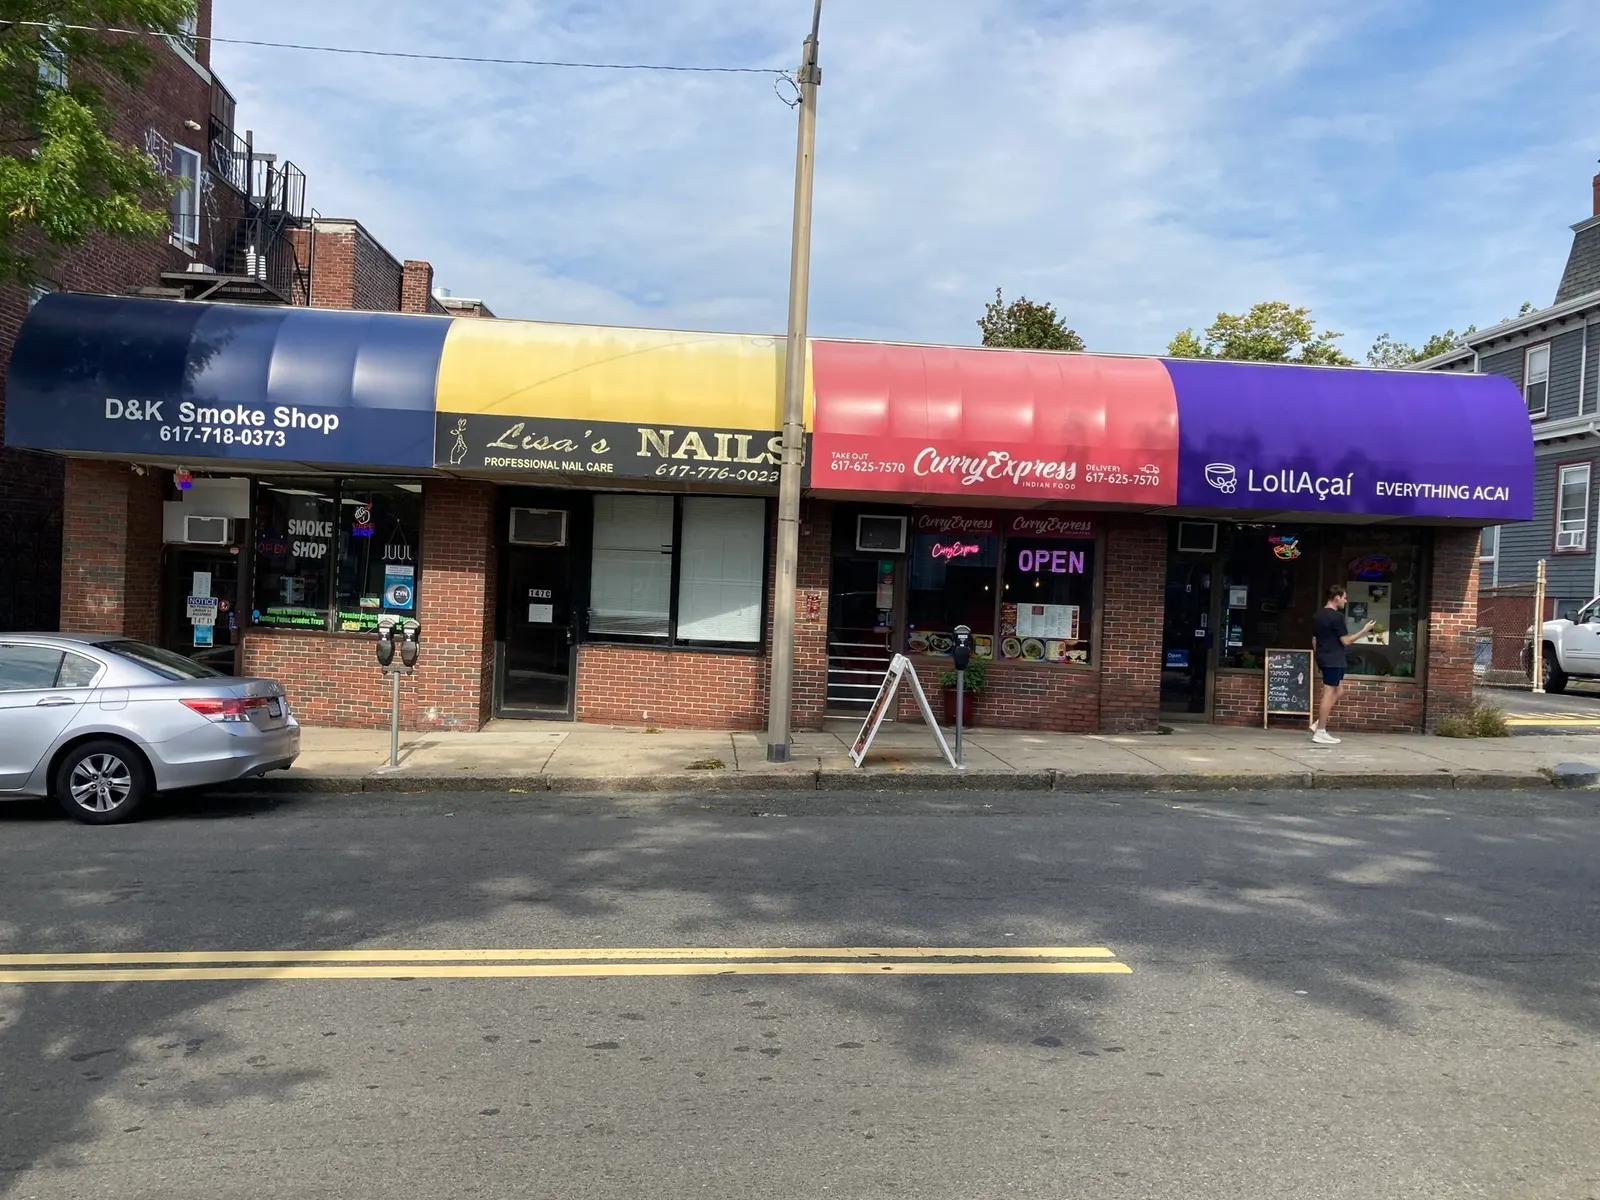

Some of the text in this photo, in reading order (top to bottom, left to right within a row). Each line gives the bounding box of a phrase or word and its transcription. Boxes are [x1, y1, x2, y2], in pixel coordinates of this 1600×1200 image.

[105, 398, 340, 435] D&K Smoke Shop
[159, 425, 286, 447] 617-718-0373
[486, 422, 611, 454] Lisa's
[831, 451, 850, 460] TAKE
[484, 456, 613, 473] PROFESSIONAL NAIL CARE
[655, 463, 780, 483] 617-776-0023
[830, 460, 906, 474] 617-625-7570
[913, 447, 1077, 486] CurryExpress
[1085, 463, 1121, 473] DELIVERY
[1022, 481, 1076, 490] INDIAN FOOD
[1085, 472, 1160, 486] 617-625-7570
[1248, 468, 1354, 501] LollAçaí
[1376, 481, 1509, 501] EVERYTHING ACAI
[288, 519, 334, 538] SMOKE
[352, 528, 374, 537] SHOP
[259, 543, 288, 554] OPEN
[292, 541, 327, 559] SHOP
[382, 544, 412, 561] JUUL
[1018, 549, 1085, 574] OPEN
[190, 597, 216, 606] NOTICE
[395, 590, 408, 598] ZYN
